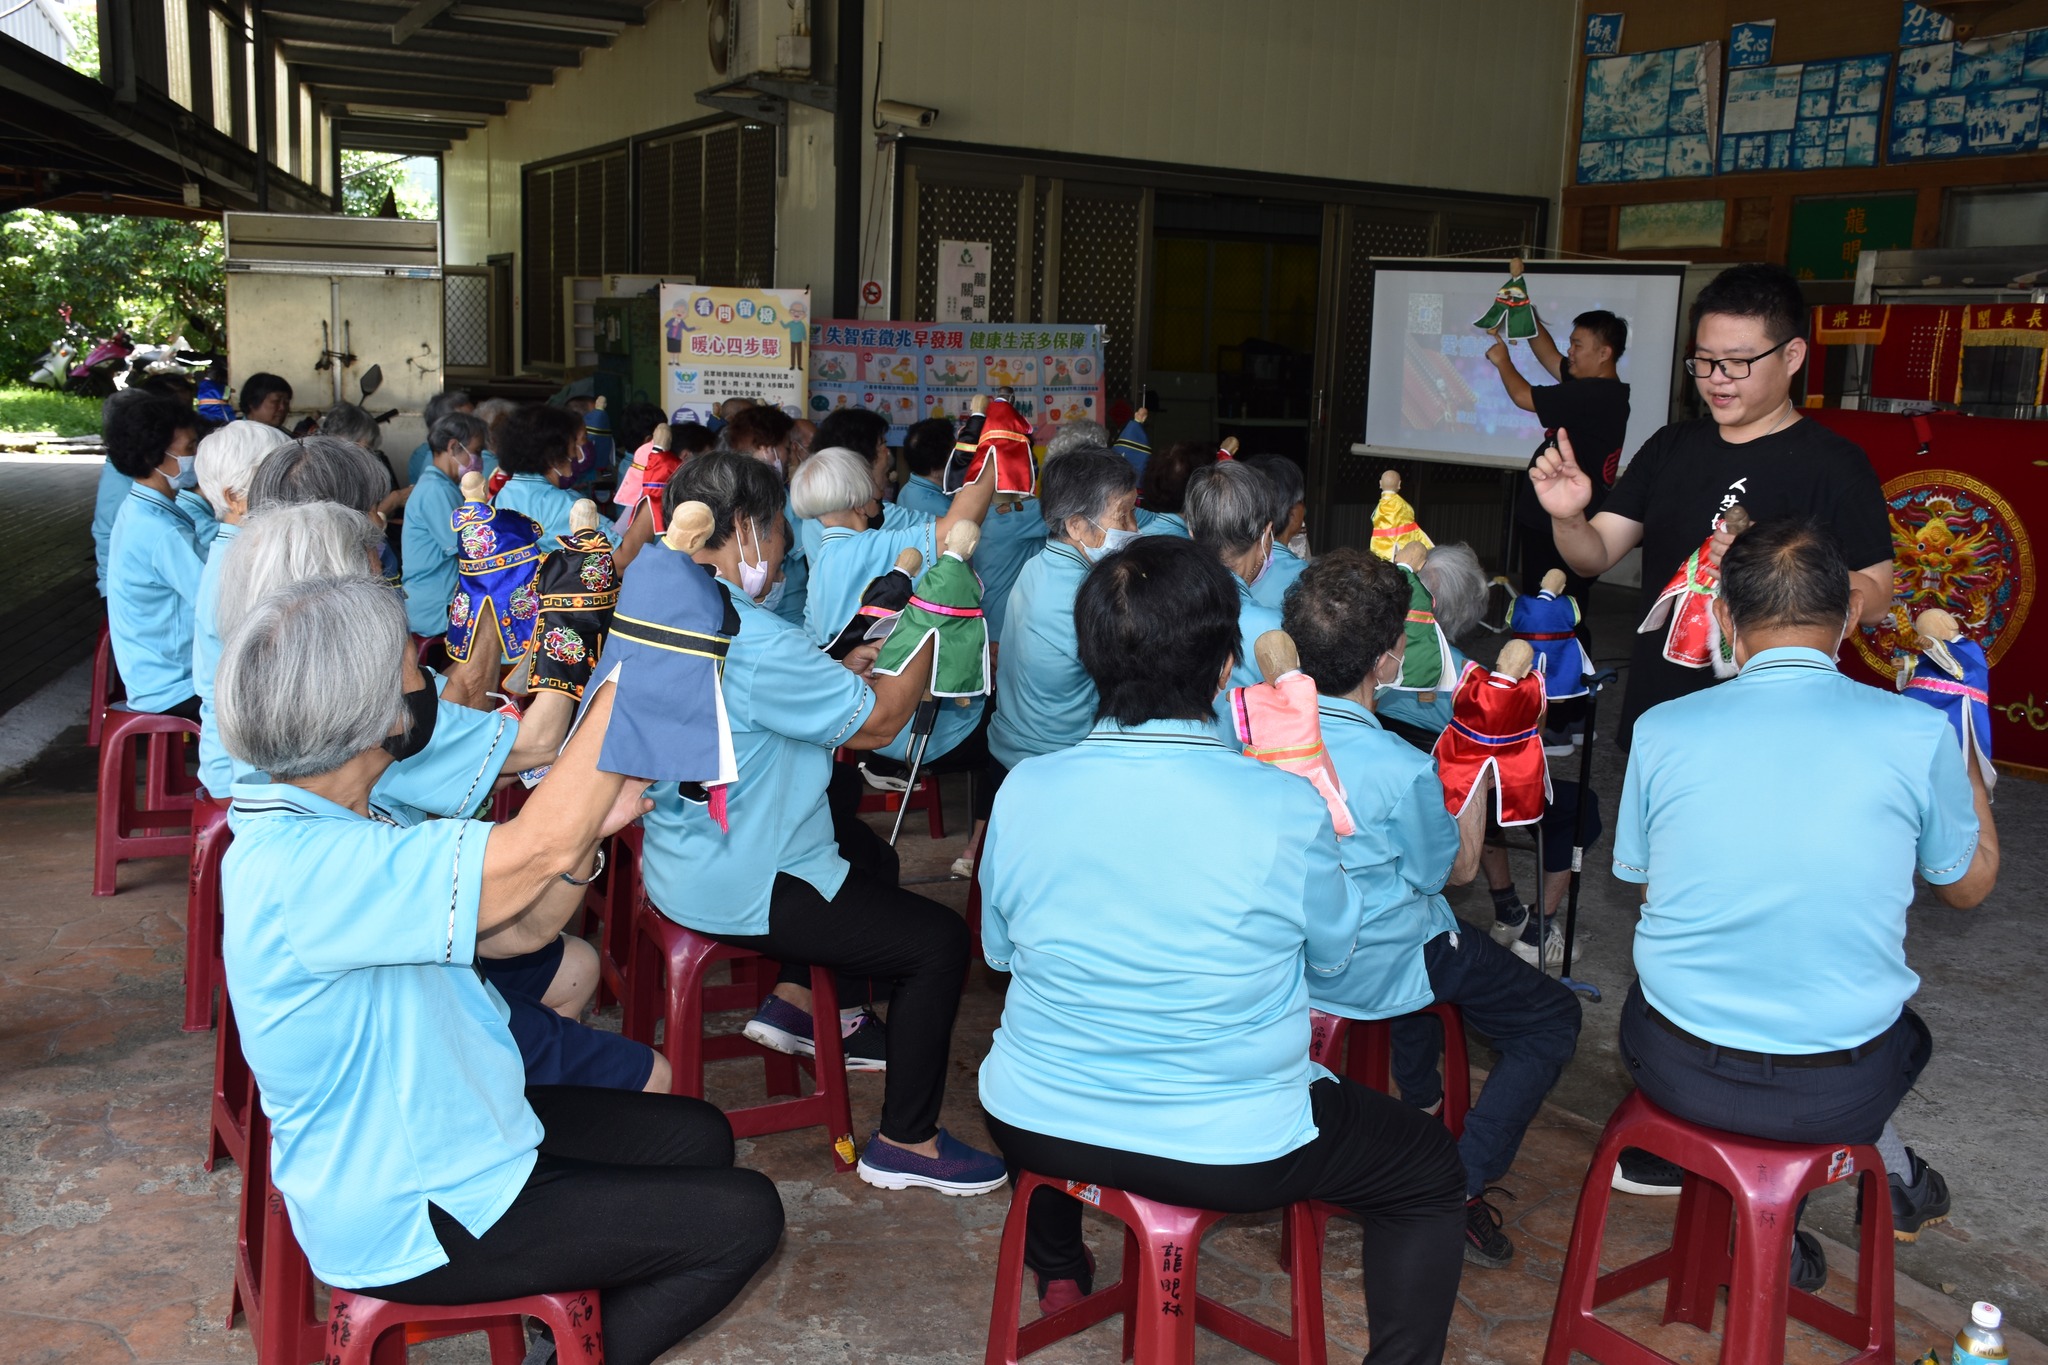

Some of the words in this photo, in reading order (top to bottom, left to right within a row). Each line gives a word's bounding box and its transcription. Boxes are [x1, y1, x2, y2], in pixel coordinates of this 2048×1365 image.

[1733, 27, 1768, 52] 安心
[697, 299, 774, 324] 看問留撥
[961, 282, 974, 321] 關懷
[972, 272, 987, 323] 龍眼
[691, 335, 779, 356] 暖心四步驟
[1711, 477, 1747, 530] 人生
[1161, 1242, 1184, 1317] 龍眼林
[566, 1292, 603, 1365] 福利
